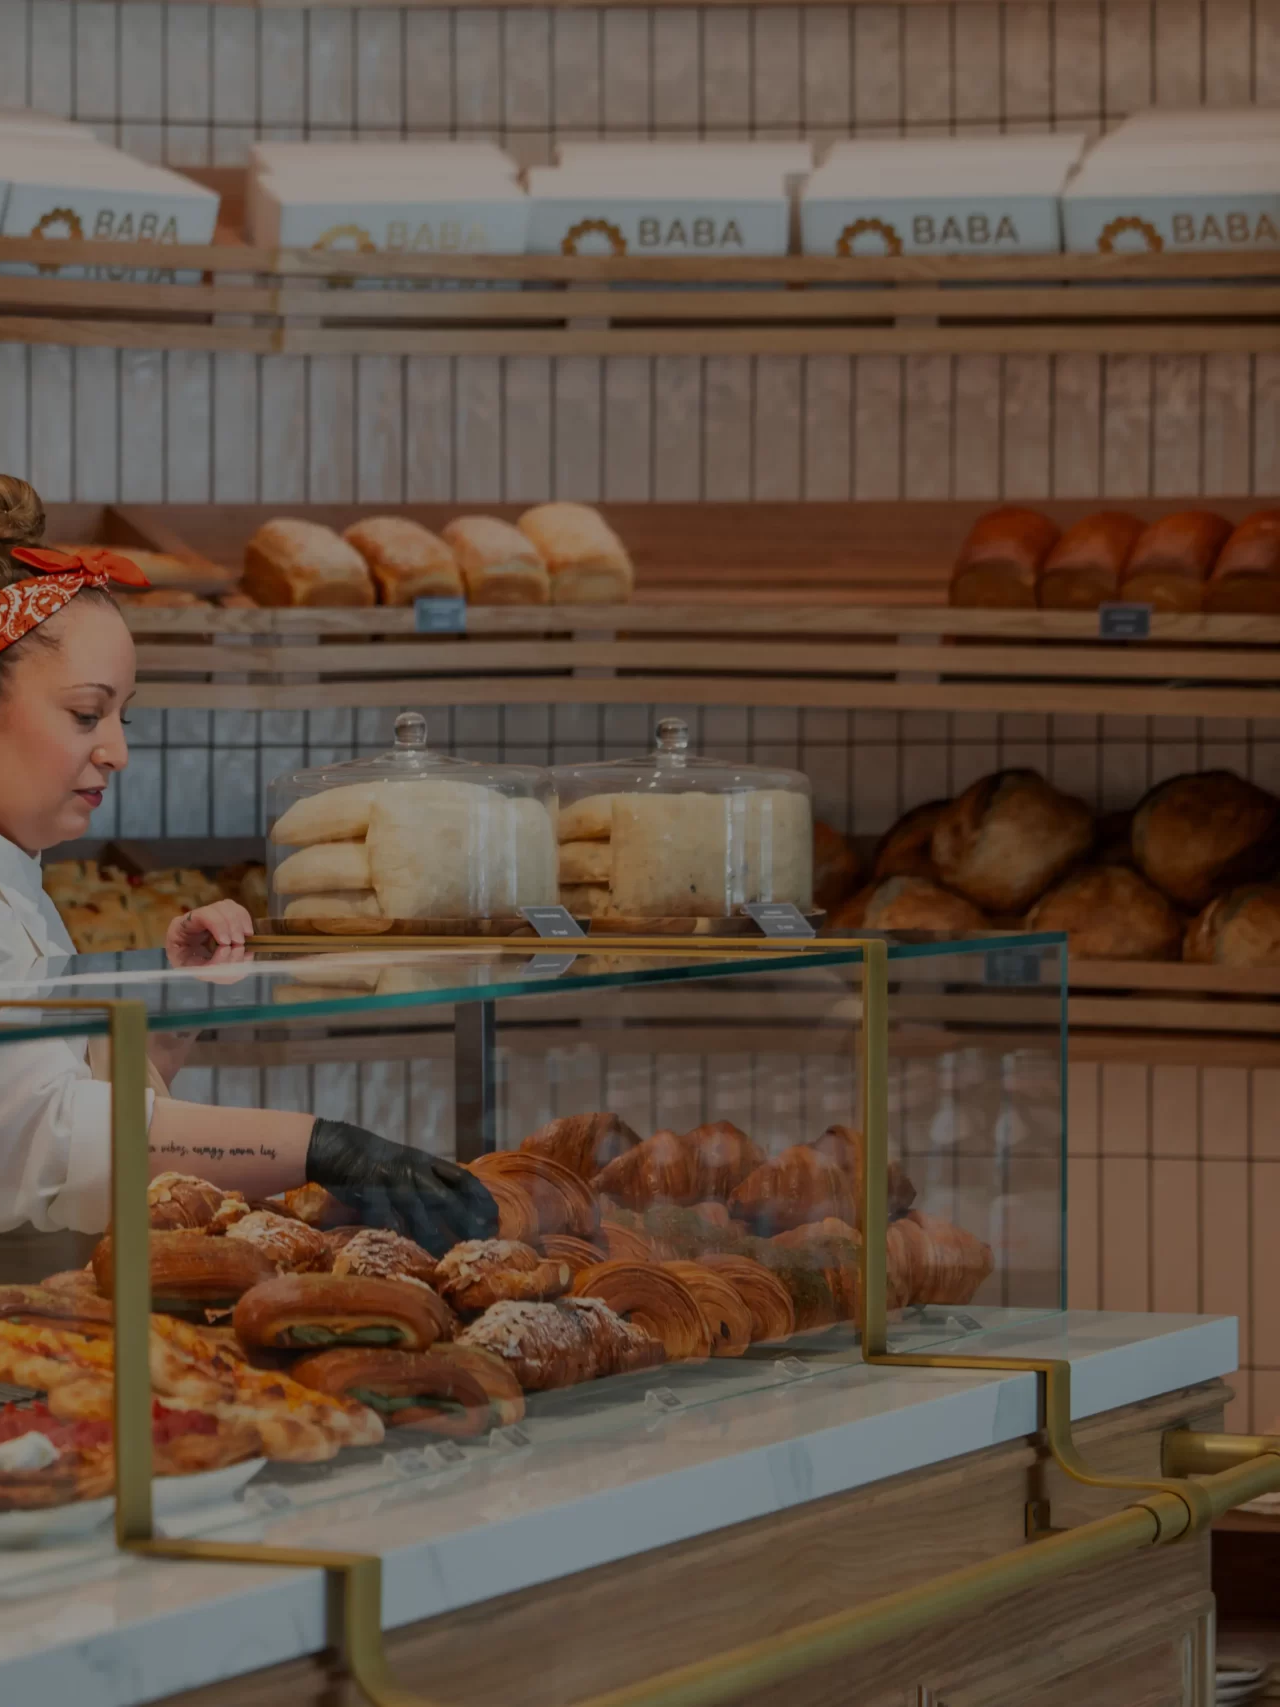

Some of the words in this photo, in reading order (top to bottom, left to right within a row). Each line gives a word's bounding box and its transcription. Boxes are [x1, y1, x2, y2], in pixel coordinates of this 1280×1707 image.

[92, 210, 179, 245] BABA
[385, 221, 490, 252] BABA
[637, 218, 744, 248] BABA
[912, 215, 1018, 245] BABA
[1172, 212, 1279, 243] BABA
